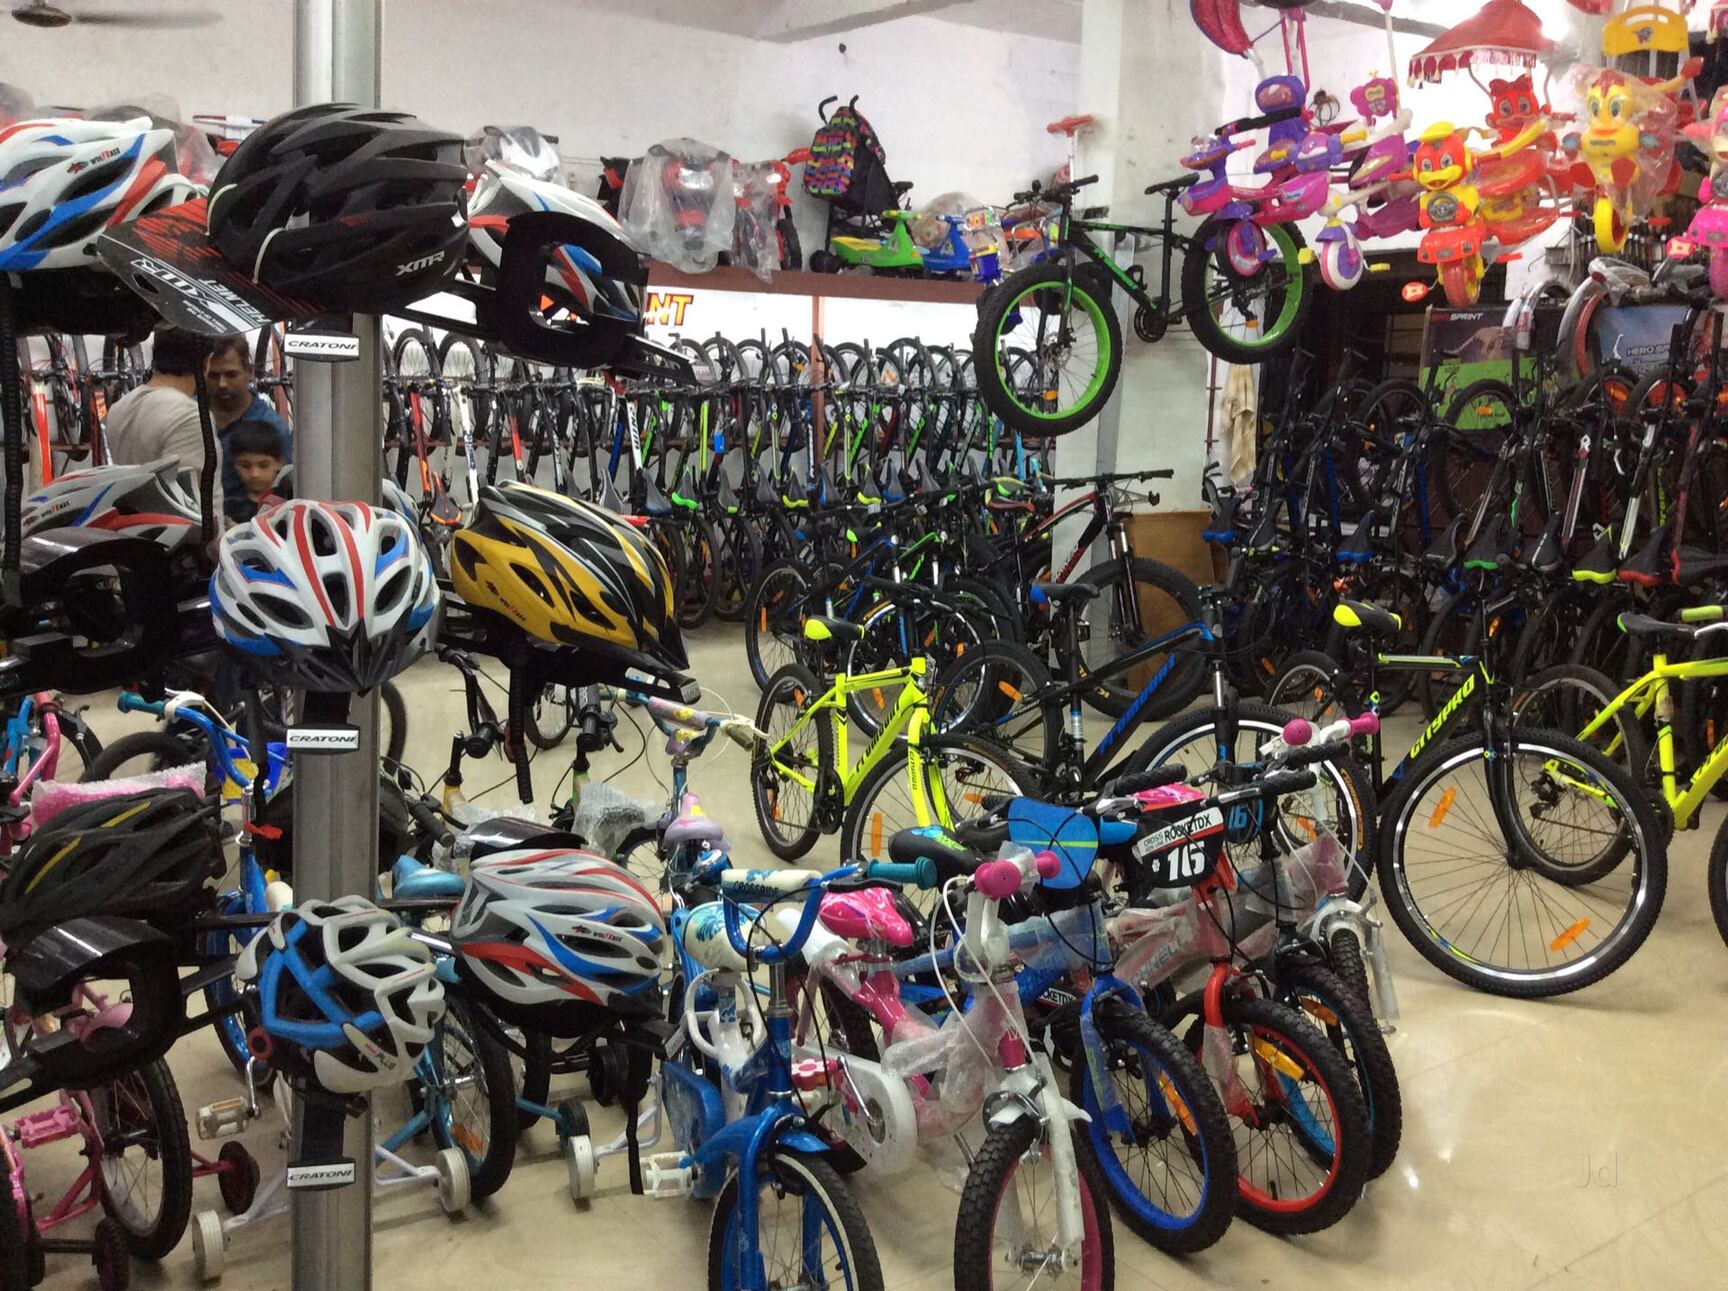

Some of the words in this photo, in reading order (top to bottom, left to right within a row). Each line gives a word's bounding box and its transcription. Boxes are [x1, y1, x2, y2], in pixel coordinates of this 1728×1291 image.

[197, 278, 272, 323] HELMET
[1450, 312, 1484, 321] SPRINT
[288, 340, 357, 350] CRATONI
[289, 735, 356, 743] CRATONI
[1163, 813, 1212, 842] ROCKETDX
[1167, 840, 1206, 881] 16
[290, 1170, 353, 1181] CRATONI
